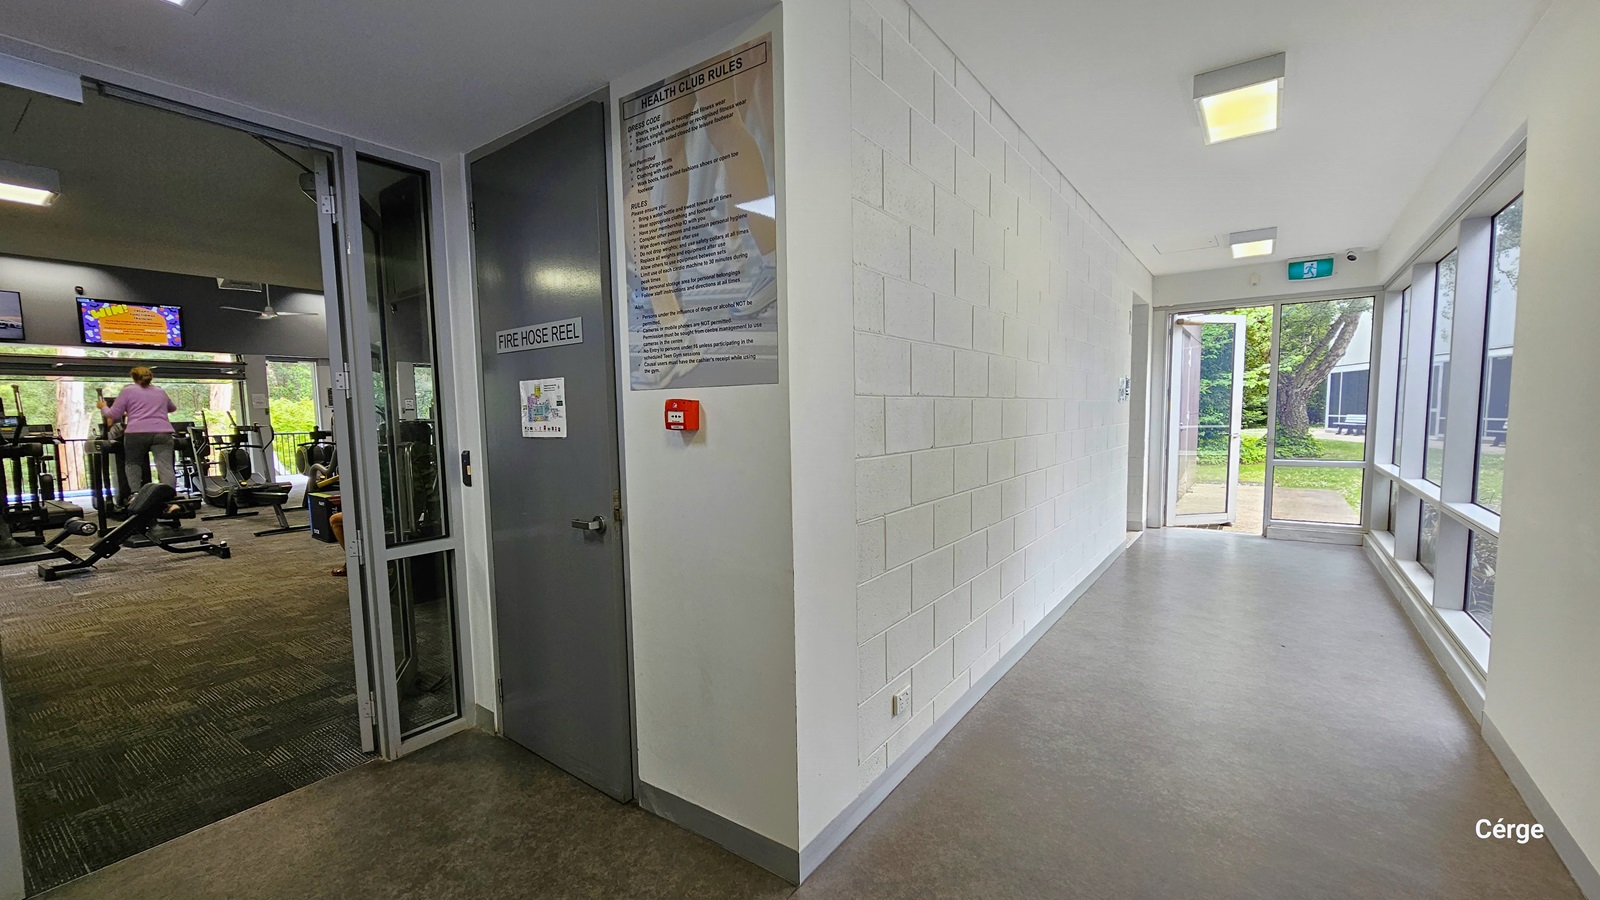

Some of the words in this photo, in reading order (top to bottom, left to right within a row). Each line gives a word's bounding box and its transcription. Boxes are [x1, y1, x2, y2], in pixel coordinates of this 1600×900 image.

[641, 85, 675, 109] HEALTH
[678, 73, 704, 93] CLUB
[708, 56, 742, 81] RULES
[627, 120, 644, 133] DRESS
[645, 113, 660, 126] CODE
[630, 199, 647, 210] RULES
[90, 304, 128, 318] WIN!
[499, 332, 519, 349] FIRE
[521, 327, 548, 346] HOSE
[552, 323, 580, 342] REEL
